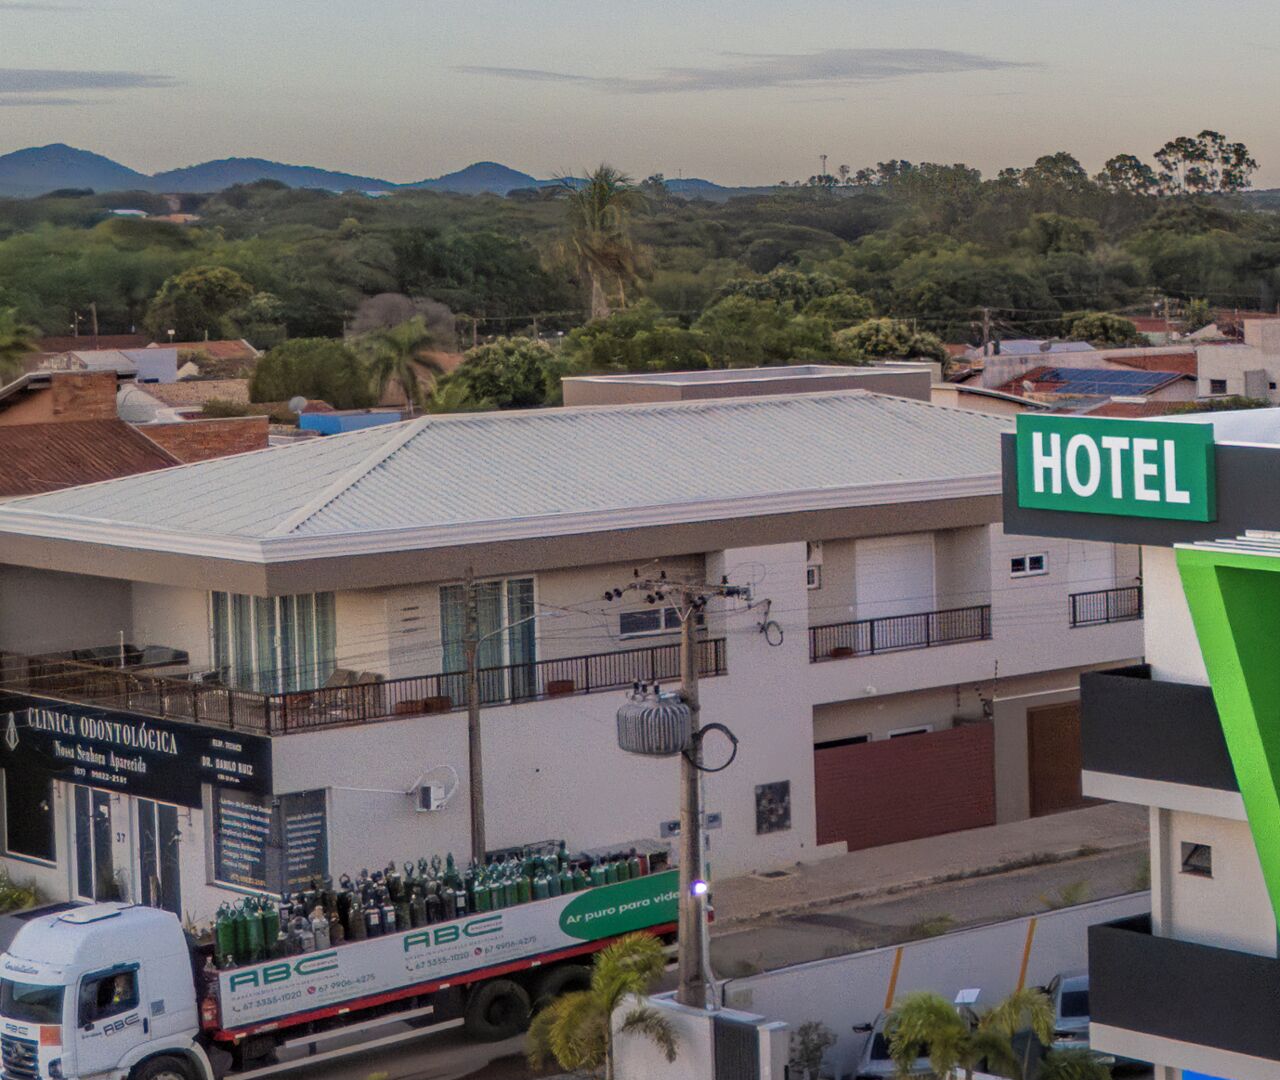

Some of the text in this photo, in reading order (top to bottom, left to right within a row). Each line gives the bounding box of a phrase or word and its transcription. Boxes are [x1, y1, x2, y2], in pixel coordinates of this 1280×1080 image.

[1032, 431, 1191, 504] HOTEL
[80, 716, 178, 755] ODONTOLÓGICA
[109, 750, 147, 774] Aparecida
[566, 914, 582, 924] Ar
[584, 907, 617, 922] puro
[618, 898, 651, 914] para
[404, 914, 504, 953] ABC
[229, 951, 339, 993] ABC
[103, 1012, 140, 1037] ABC
